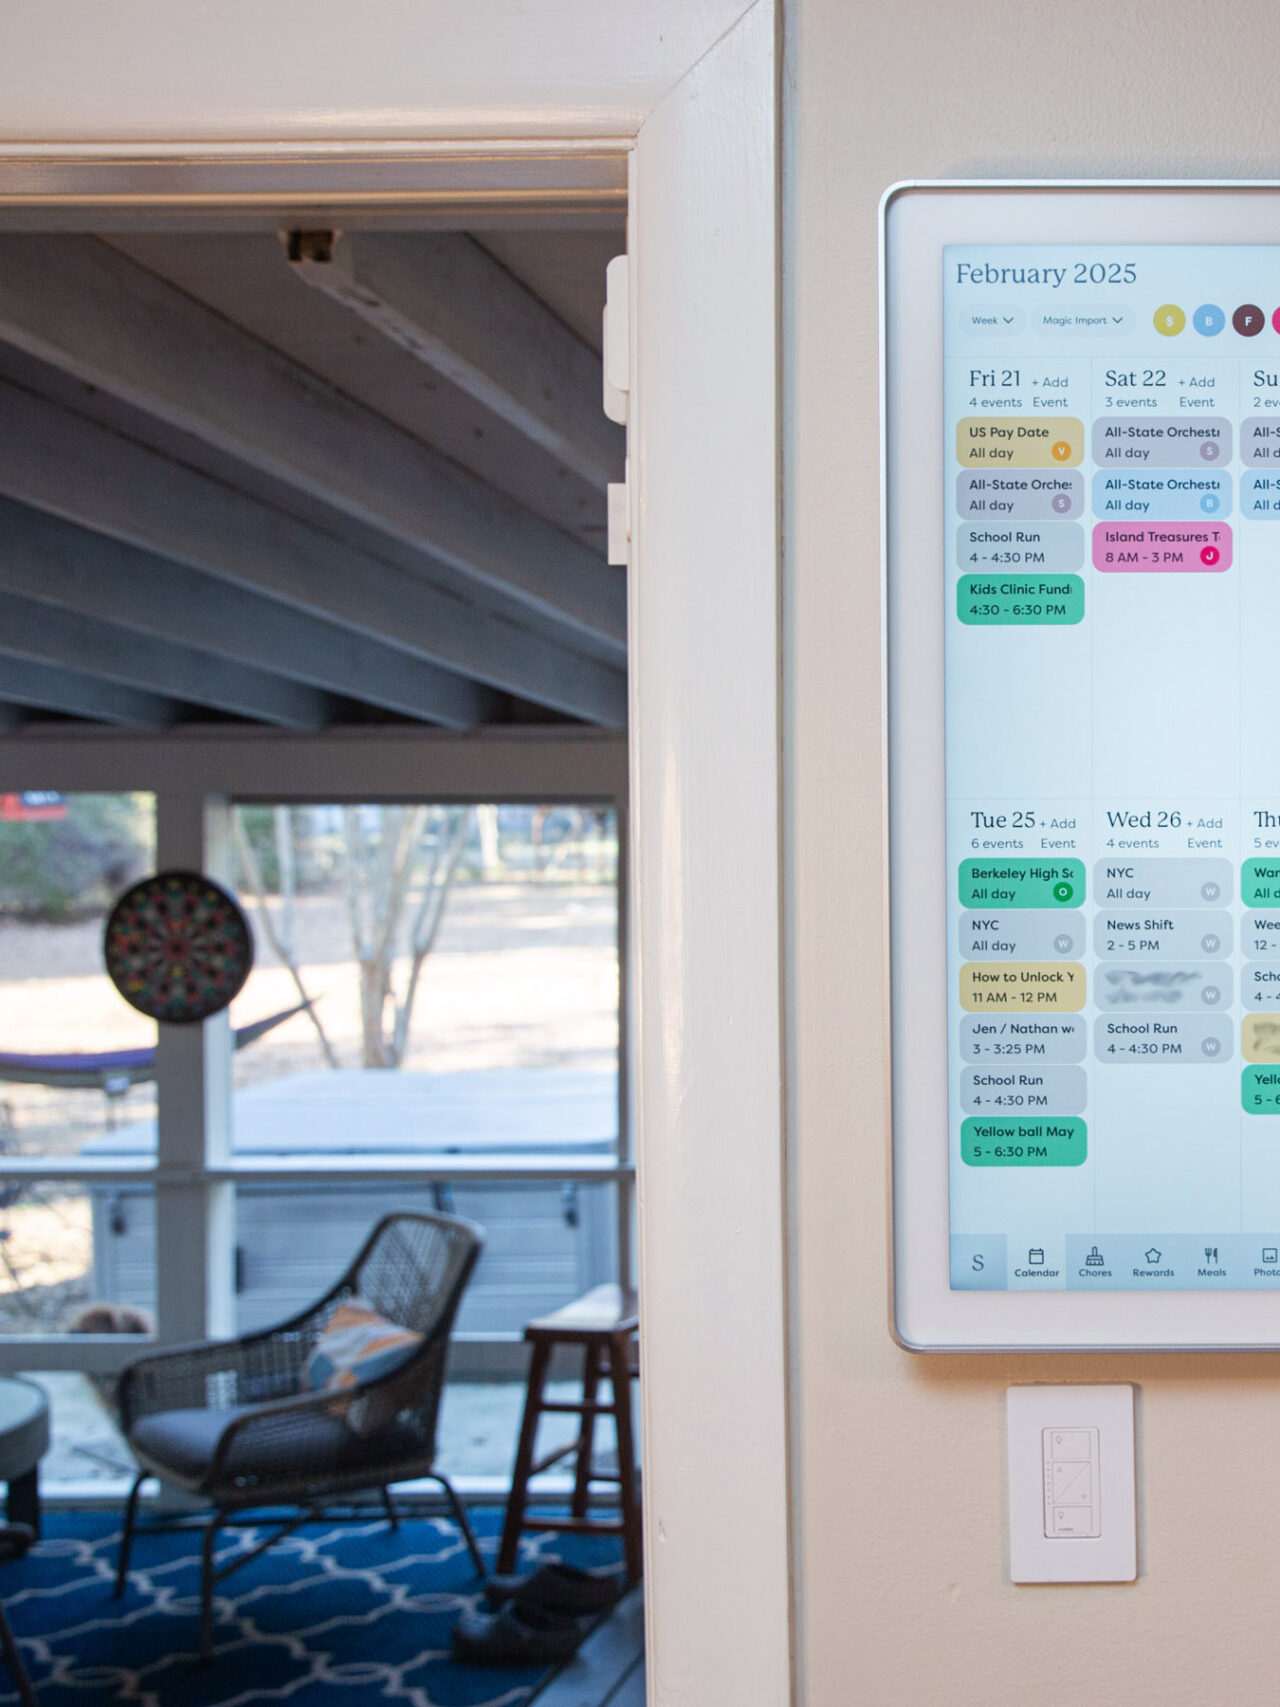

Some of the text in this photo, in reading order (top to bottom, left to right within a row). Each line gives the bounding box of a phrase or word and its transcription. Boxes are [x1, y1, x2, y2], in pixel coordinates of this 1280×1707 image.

[956, 262, 1137, 289] February 2025
[971, 316, 999, 325] Week
[1042, 316, 1108, 327] Magic Import
[1165, 315, 1174, 328] S
[1204, 315, 1214, 327] B
[1244, 315, 1253, 327] F
[970, 369, 1020, 387] Fri 21
[1042, 376, 1069, 388] Add
[1105, 369, 1167, 387] Sat 22
[1188, 376, 1216, 388] Add
[968, 396, 1023, 408] 4 events
[1032, 396, 1069, 408] Event
[1105, 396, 1158, 408] 3 events
[1179, 396, 1216, 408] Event
[1253, 396, 1262, 408] 2
[969, 426, 1050, 441] US Pay Date
[1104, 426, 1164, 438] All-State
[968, 447, 1014, 461] All day
[1104, 447, 1151, 461] All day
[1252, 447, 1270, 458] All
[969, 479, 1029, 491] All-State
[1104, 478, 1164, 490] All-State
[969, 499, 1015, 514] All day
[1105, 499, 1150, 514] All day
[1253, 499, 1270, 511] All
[969, 531, 1041, 543] School Run
[1105, 531, 1209, 543] Island Treasures
[970, 583, 997, 595] Kids
[999, 583, 1036, 595] Clinic
[970, 811, 1036, 829] Tue 25
[1049, 818, 1077, 829] Add
[1106, 810, 1182, 828] Wed 26
[1196, 817, 1223, 829] Add
[971, 838, 1024, 849] 6 events
[1040, 837, 1077, 849] Event
[1106, 838, 1160, 849] 4 events
[1187, 837, 1224, 849] Event
[1253, 837, 1263, 849] 5
[971, 867, 1059, 882] Berkeley High
[1106, 867, 1134, 879] NYC
[971, 888, 1016, 902] All day
[1106, 888, 1151, 902] All day
[1253, 887, 1271, 899] All
[972, 919, 1000, 931] NYC
[1107, 919, 1175, 931] News Shift
[971, 940, 1017, 954] All day
[972, 971, 1064, 983] How to Unlock
[972, 1023, 1058, 1035] Jen Nathan
[1107, 1022, 1178, 1034] School Run
[972, 1074, 1044, 1086] School Run
[973, 1125, 1075, 1140] Yellow ball May
[971, 1254, 985, 1272] S
[1014, 1268, 1060, 1278] Calendar
[1078, 1268, 1113, 1278] Chores
[1132, 1268, 1175, 1277] Rewards
[1197, 1268, 1227, 1277] Meals
